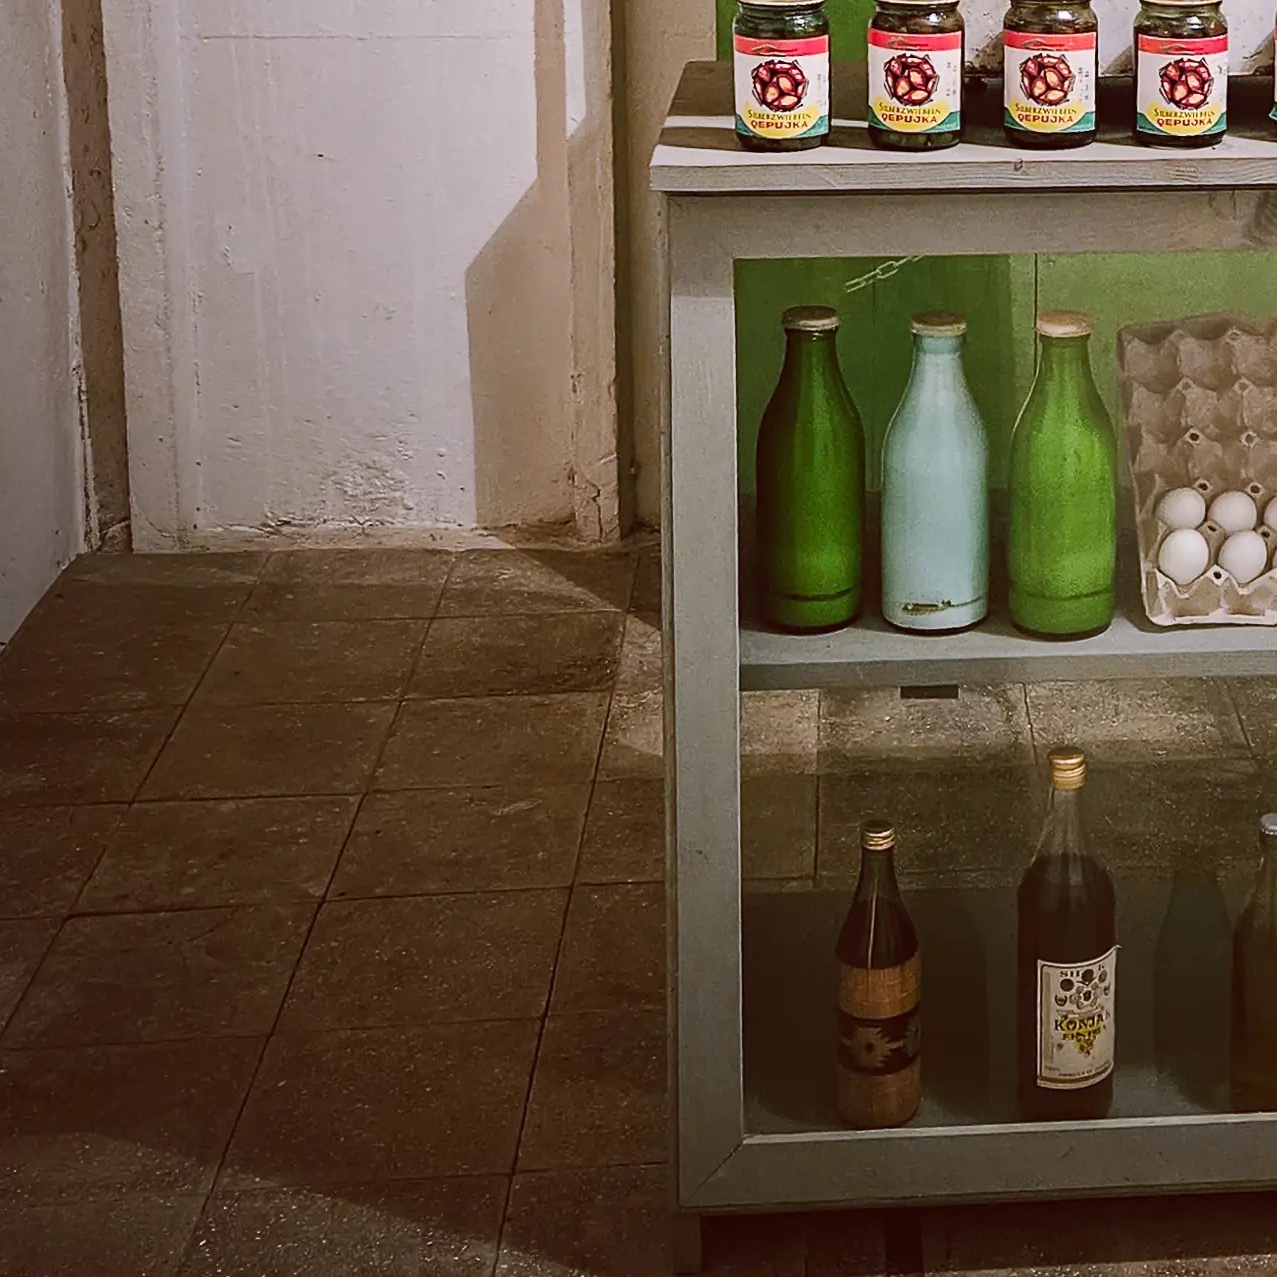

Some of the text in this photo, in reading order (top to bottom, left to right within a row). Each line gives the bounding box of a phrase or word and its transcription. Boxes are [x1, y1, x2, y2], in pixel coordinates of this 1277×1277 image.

[881, 112, 938, 123] QEPUJKA
[1017, 112, 1074, 123] QEPUJKA
[1156, 118, 1213, 127] QEPUJKA
[750, 119, 809, 129] QEPUJKA
